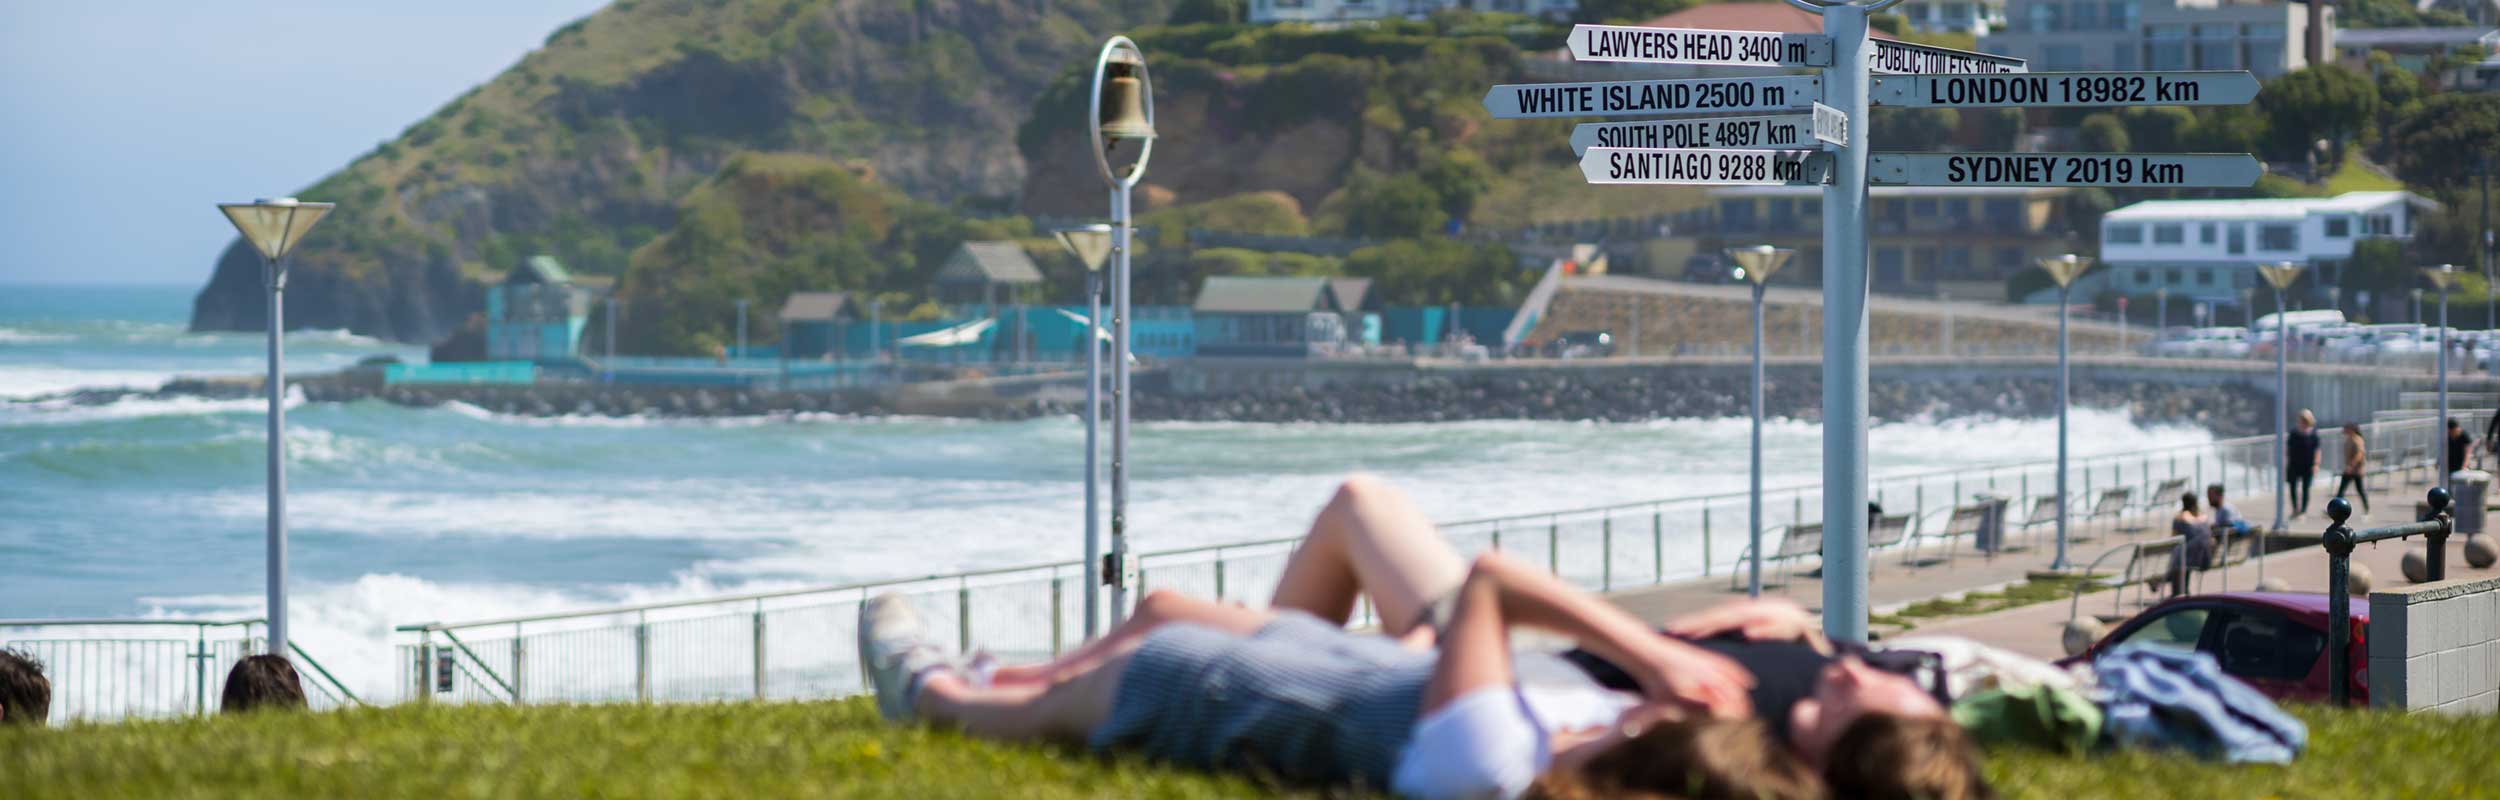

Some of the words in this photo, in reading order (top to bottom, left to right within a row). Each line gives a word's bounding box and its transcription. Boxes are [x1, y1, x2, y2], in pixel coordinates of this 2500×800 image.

[1588, 30, 1678, 59] LAWYERS
[1684, 34, 1732, 61] HEAD
[1739, 35, 1782, 62] 3400
[1788, 42, 1804, 62] m
[1877, 44, 1921, 74] PUBLIC
[1518, 87, 1592, 113] WHITE
[1602, 84, 1690, 111] ISLAND
[1696, 82, 1754, 108] 2500
[1763, 86, 1784, 106] m
[1931, 78, 2048, 104] LONDON
[2059, 77, 2145, 103] 18982
[2156, 77, 2199, 101] km
[1598, 125, 1657, 148] SOUTH
[1664, 123, 1709, 148] POLE
[1716, 121, 1760, 146] 4897
[1767, 121, 1796, 145] km
[1610, 153, 1711, 180] SANTIAGO
[1719, 154, 1765, 181] 9288
[1773, 155, 1801, 181] km
[1948, 156, 2057, 183] SYDNEY
[2066, 158, 2133, 183] 2019
[2142, 158, 2184, 184] km
